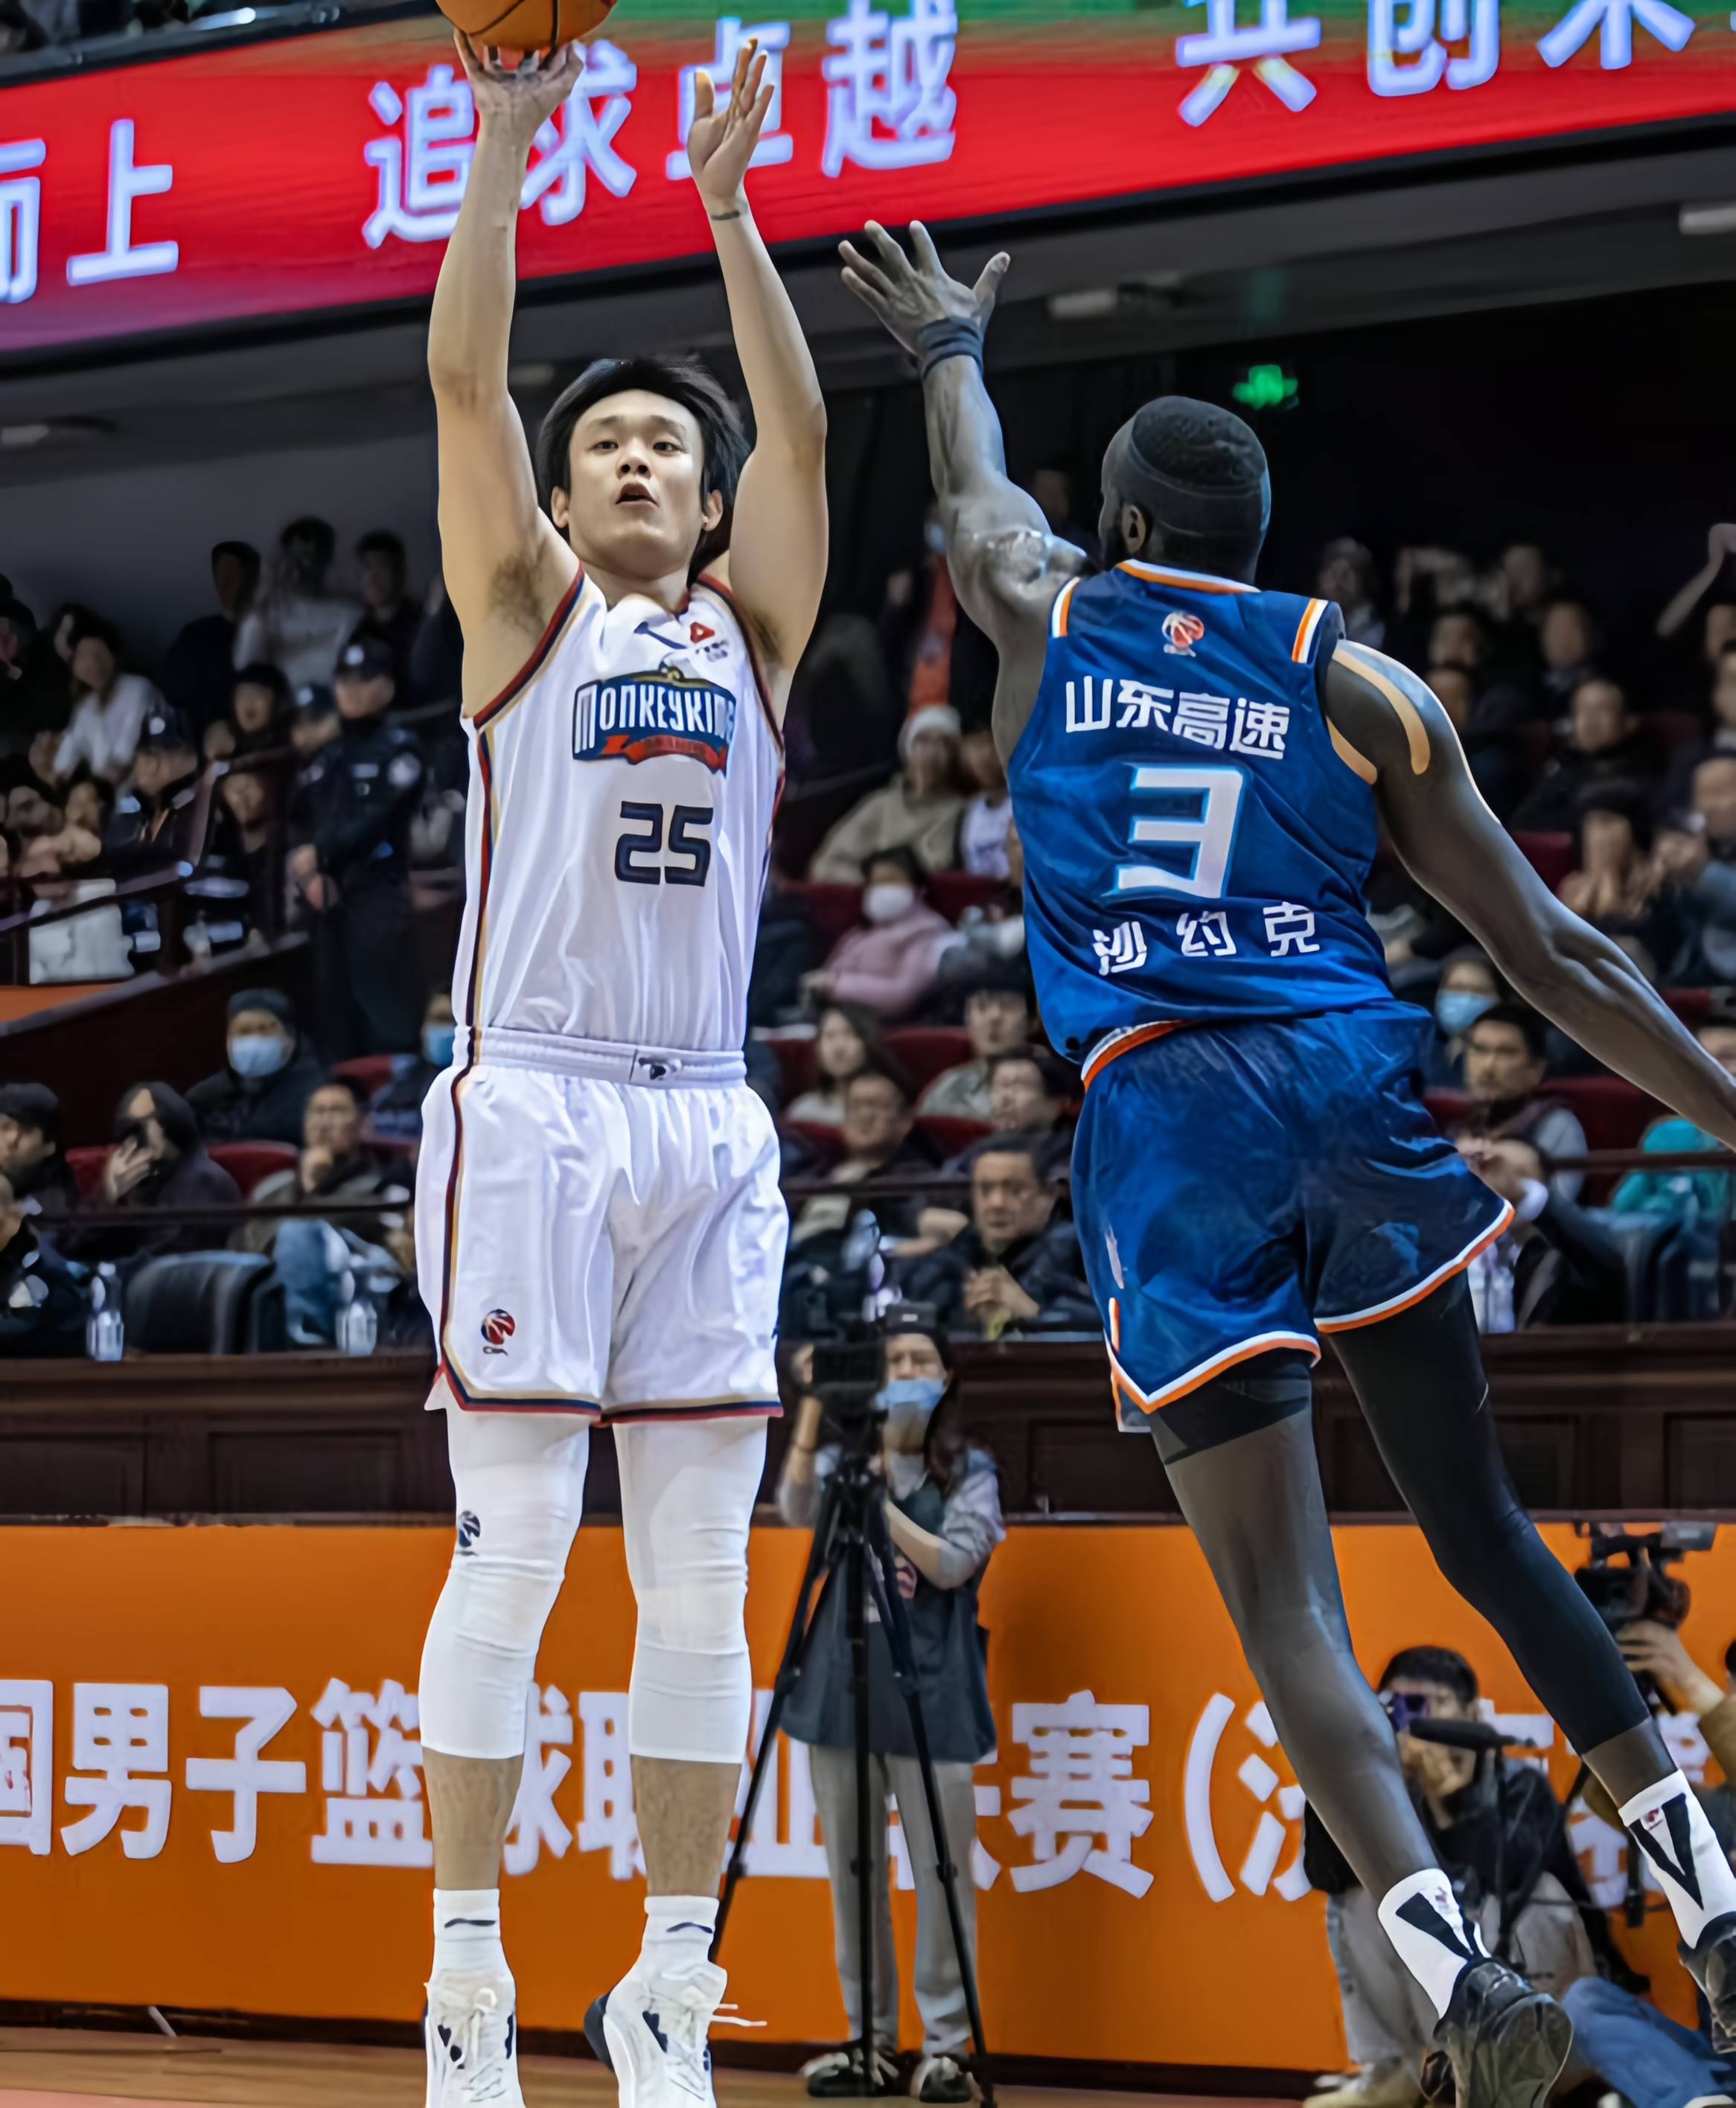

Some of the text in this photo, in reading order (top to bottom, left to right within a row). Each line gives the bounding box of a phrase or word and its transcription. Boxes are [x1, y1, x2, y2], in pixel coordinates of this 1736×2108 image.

[1065, 675, 1291, 760] 山东高速
[614, 800, 714, 887] 25
[1115, 764, 1246, 899] 3
[1091, 901, 1321, 976] 沙约克
